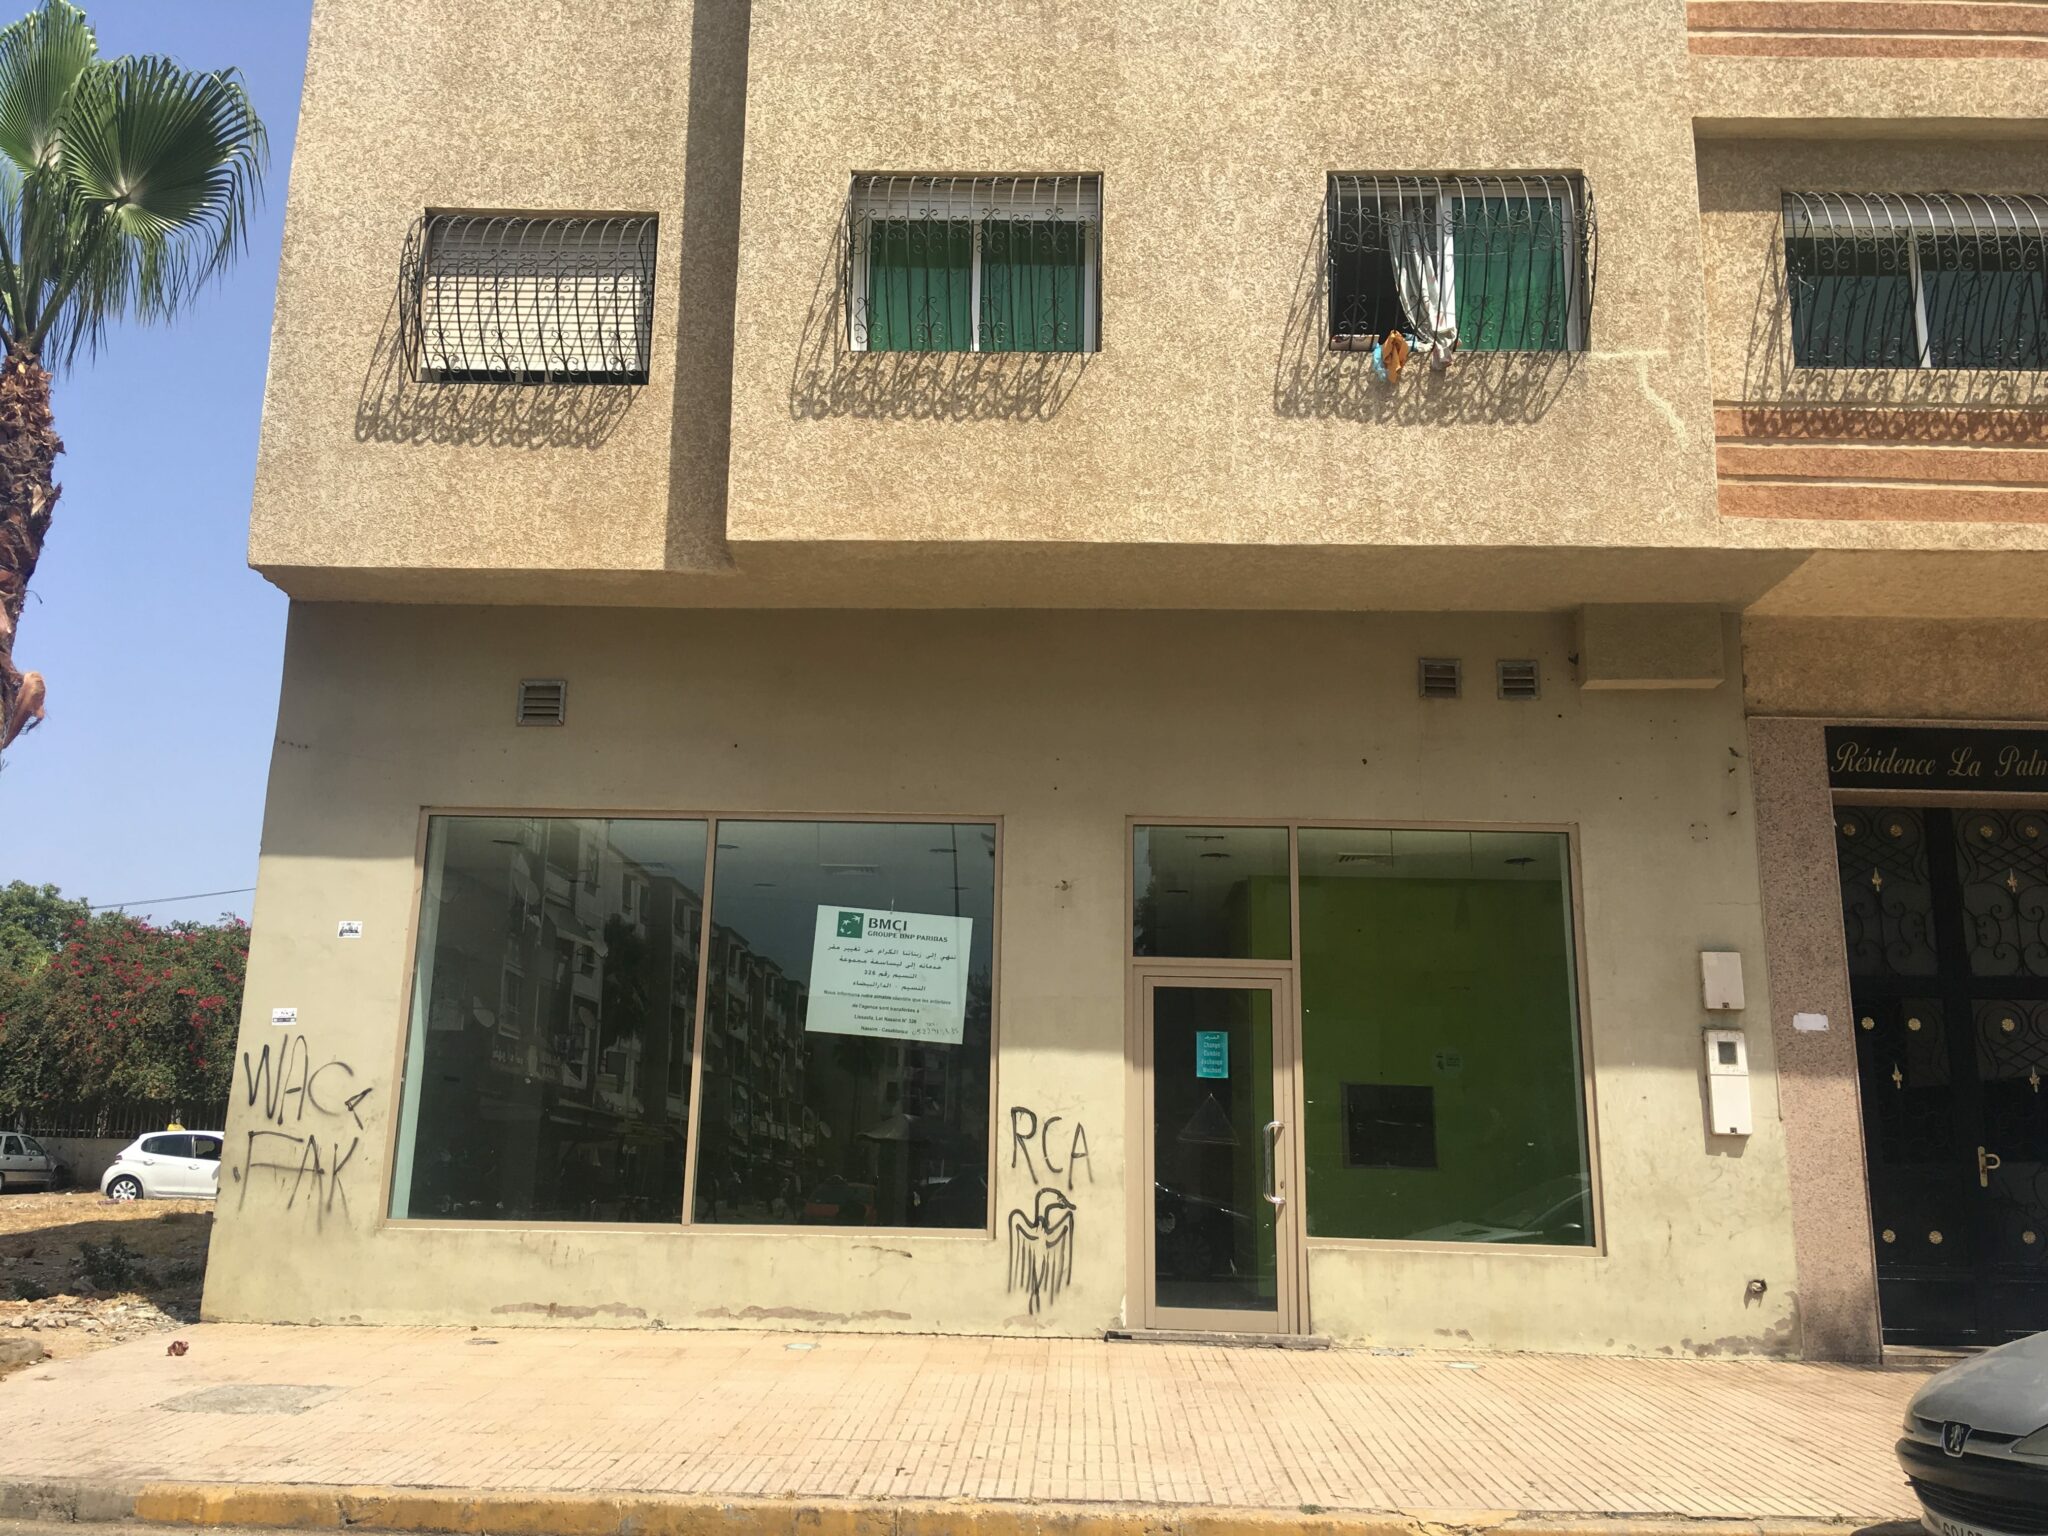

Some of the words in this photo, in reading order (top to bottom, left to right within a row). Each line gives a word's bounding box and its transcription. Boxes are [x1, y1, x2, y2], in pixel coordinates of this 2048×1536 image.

[1830, 741, 1936, 776] Résidence
[1947, 746, 1982, 777] La
[867, 930, 898, 939] GROUPE
[916, 934, 948, 943] PARIBAS
[868, 917, 908, 931] BMCI
[1011, 1106, 1095, 1190] RCA
[237, 1132, 360, 1236] FAK
